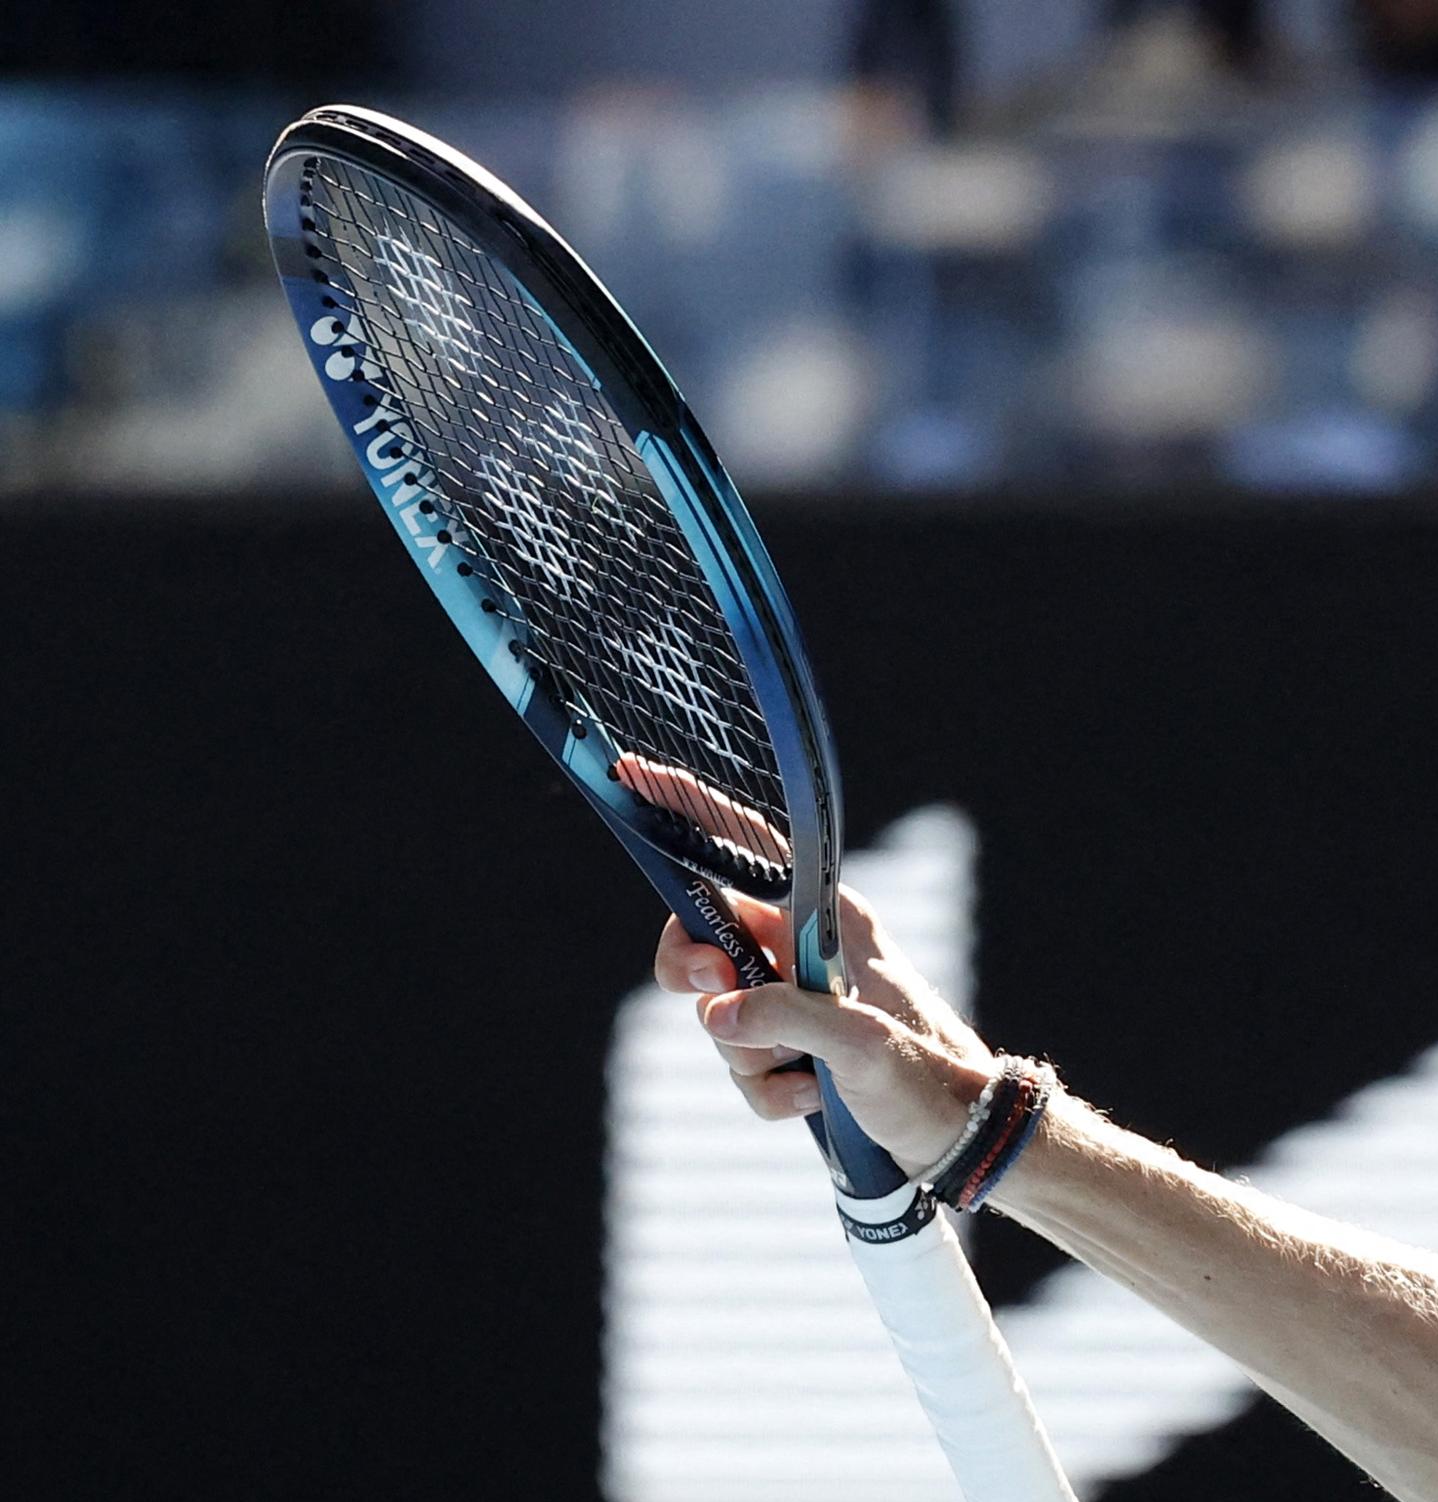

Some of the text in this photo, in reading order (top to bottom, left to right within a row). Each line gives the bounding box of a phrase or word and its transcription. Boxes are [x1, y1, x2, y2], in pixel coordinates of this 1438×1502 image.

[353, 392, 470, 569] YONEX
[686, 880, 744, 958] Fearless
[856, 1222, 909, 1240] YONEX
